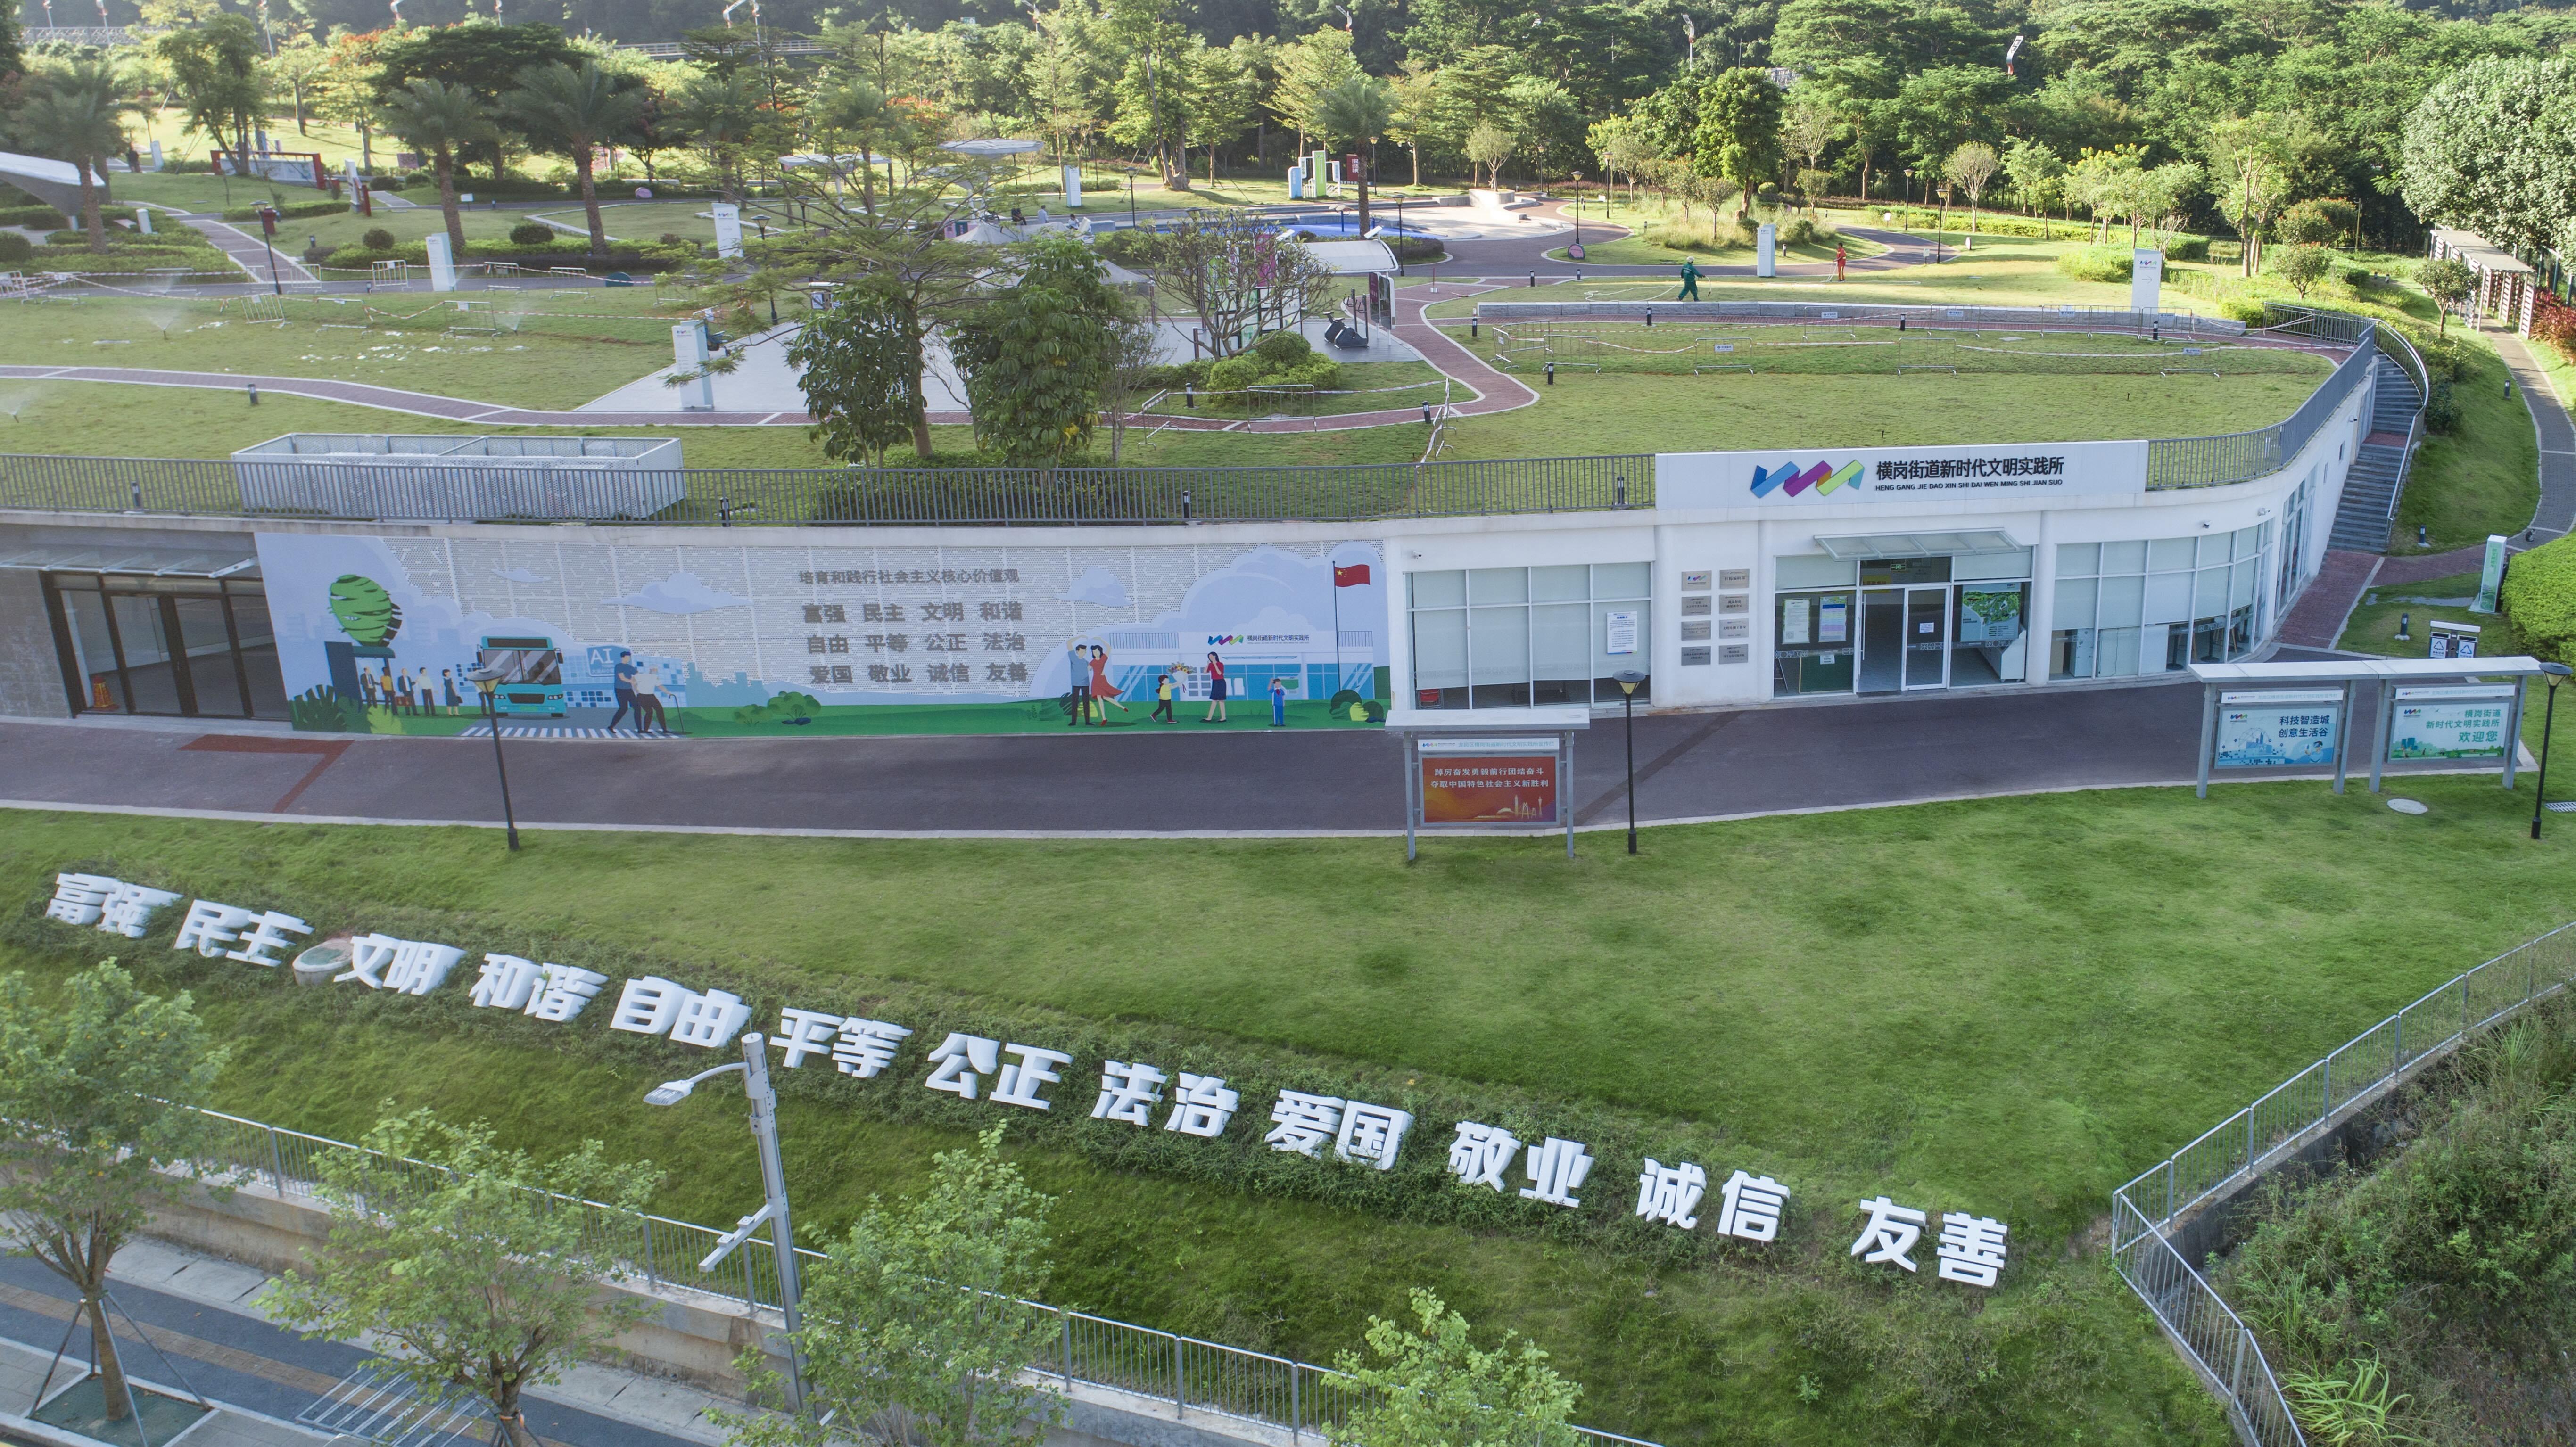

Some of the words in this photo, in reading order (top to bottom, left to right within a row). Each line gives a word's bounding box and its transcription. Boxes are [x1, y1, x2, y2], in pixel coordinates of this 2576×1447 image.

[1876, 456, 2064, 480] 横岗街道新时代文明实践所
[800, 569, 1020, 585] 培育和践行社会主义核心价值观
[802, 603, 847, 623] 富强
[863, 603, 906, 623] 民主
[921, 602, 965, 622] 文明
[979, 601, 1023, 621] 和谐
[807, 634, 849, 654] 自由
[866, 633, 908, 653] 平等
[925, 633, 967, 651] 公正
[983, 632, 1026, 651] 法治
[590, 648, 614, 664] AI
[809, 664, 853, 684] 爱国
[868, 664, 912, 683] 敬业
[927, 663, 970, 682] 诚信
[986, 662, 1028, 682] 友善
[2464, 709, 2501, 717] 横岗街道
[2279, 715, 2330, 726] 科技智造城
[2426, 719, 2500, 729] 新时代文明实践所
[2279, 727, 2328, 738] 创意生活谷
[2459, 730, 2498, 743] 欢迎您
[1435, 768, 1544, 777] 踔厉奋发勇毅前行团结奋斗
[1430, 780, 1549, 788] 夺取中国特色社会主义新胜利
[45, 873, 184, 938] 富强
[173, 899, 315, 967] 民主
[333, 933, 468, 995] 文明
[469, 952, 609, 1022] 和谐
[610, 975, 752, 1048] 自由
[769, 1007, 913, 1078] 平等
[925, 1032, 1074, 1110] 公正
[1090, 1060, 1240, 1137] 法治
[1264, 1089, 1415, 1170] 爱国
[1447, 1120, 1595, 1209] 敬业
[1635, 1157, 1791, 1244] 诚信
[1851, 1195, 2008, 1289] 友善
